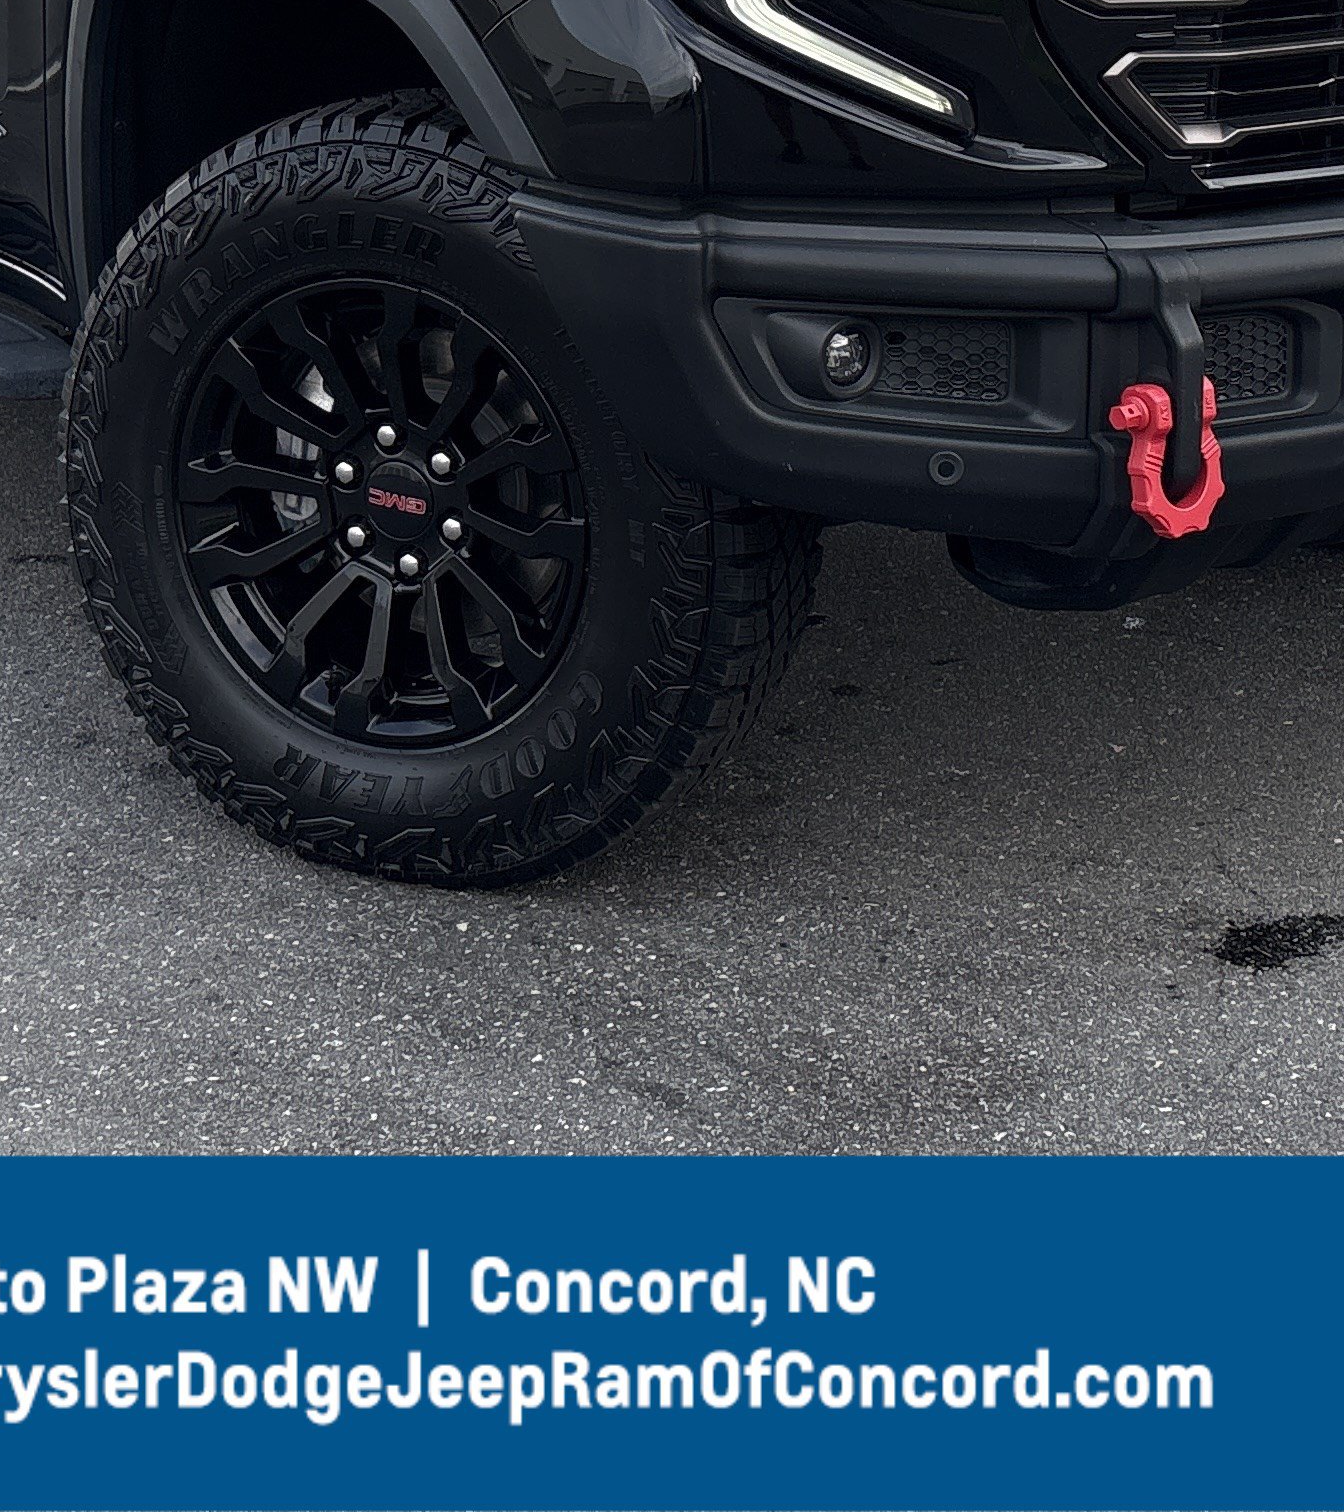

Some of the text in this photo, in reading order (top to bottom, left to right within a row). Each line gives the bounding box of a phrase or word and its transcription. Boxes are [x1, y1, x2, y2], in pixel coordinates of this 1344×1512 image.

[147, 210, 446, 356] WRANGLER
[368, 487, 427, 516] GMC
[272, 671, 603, 819] GOODYEAR
